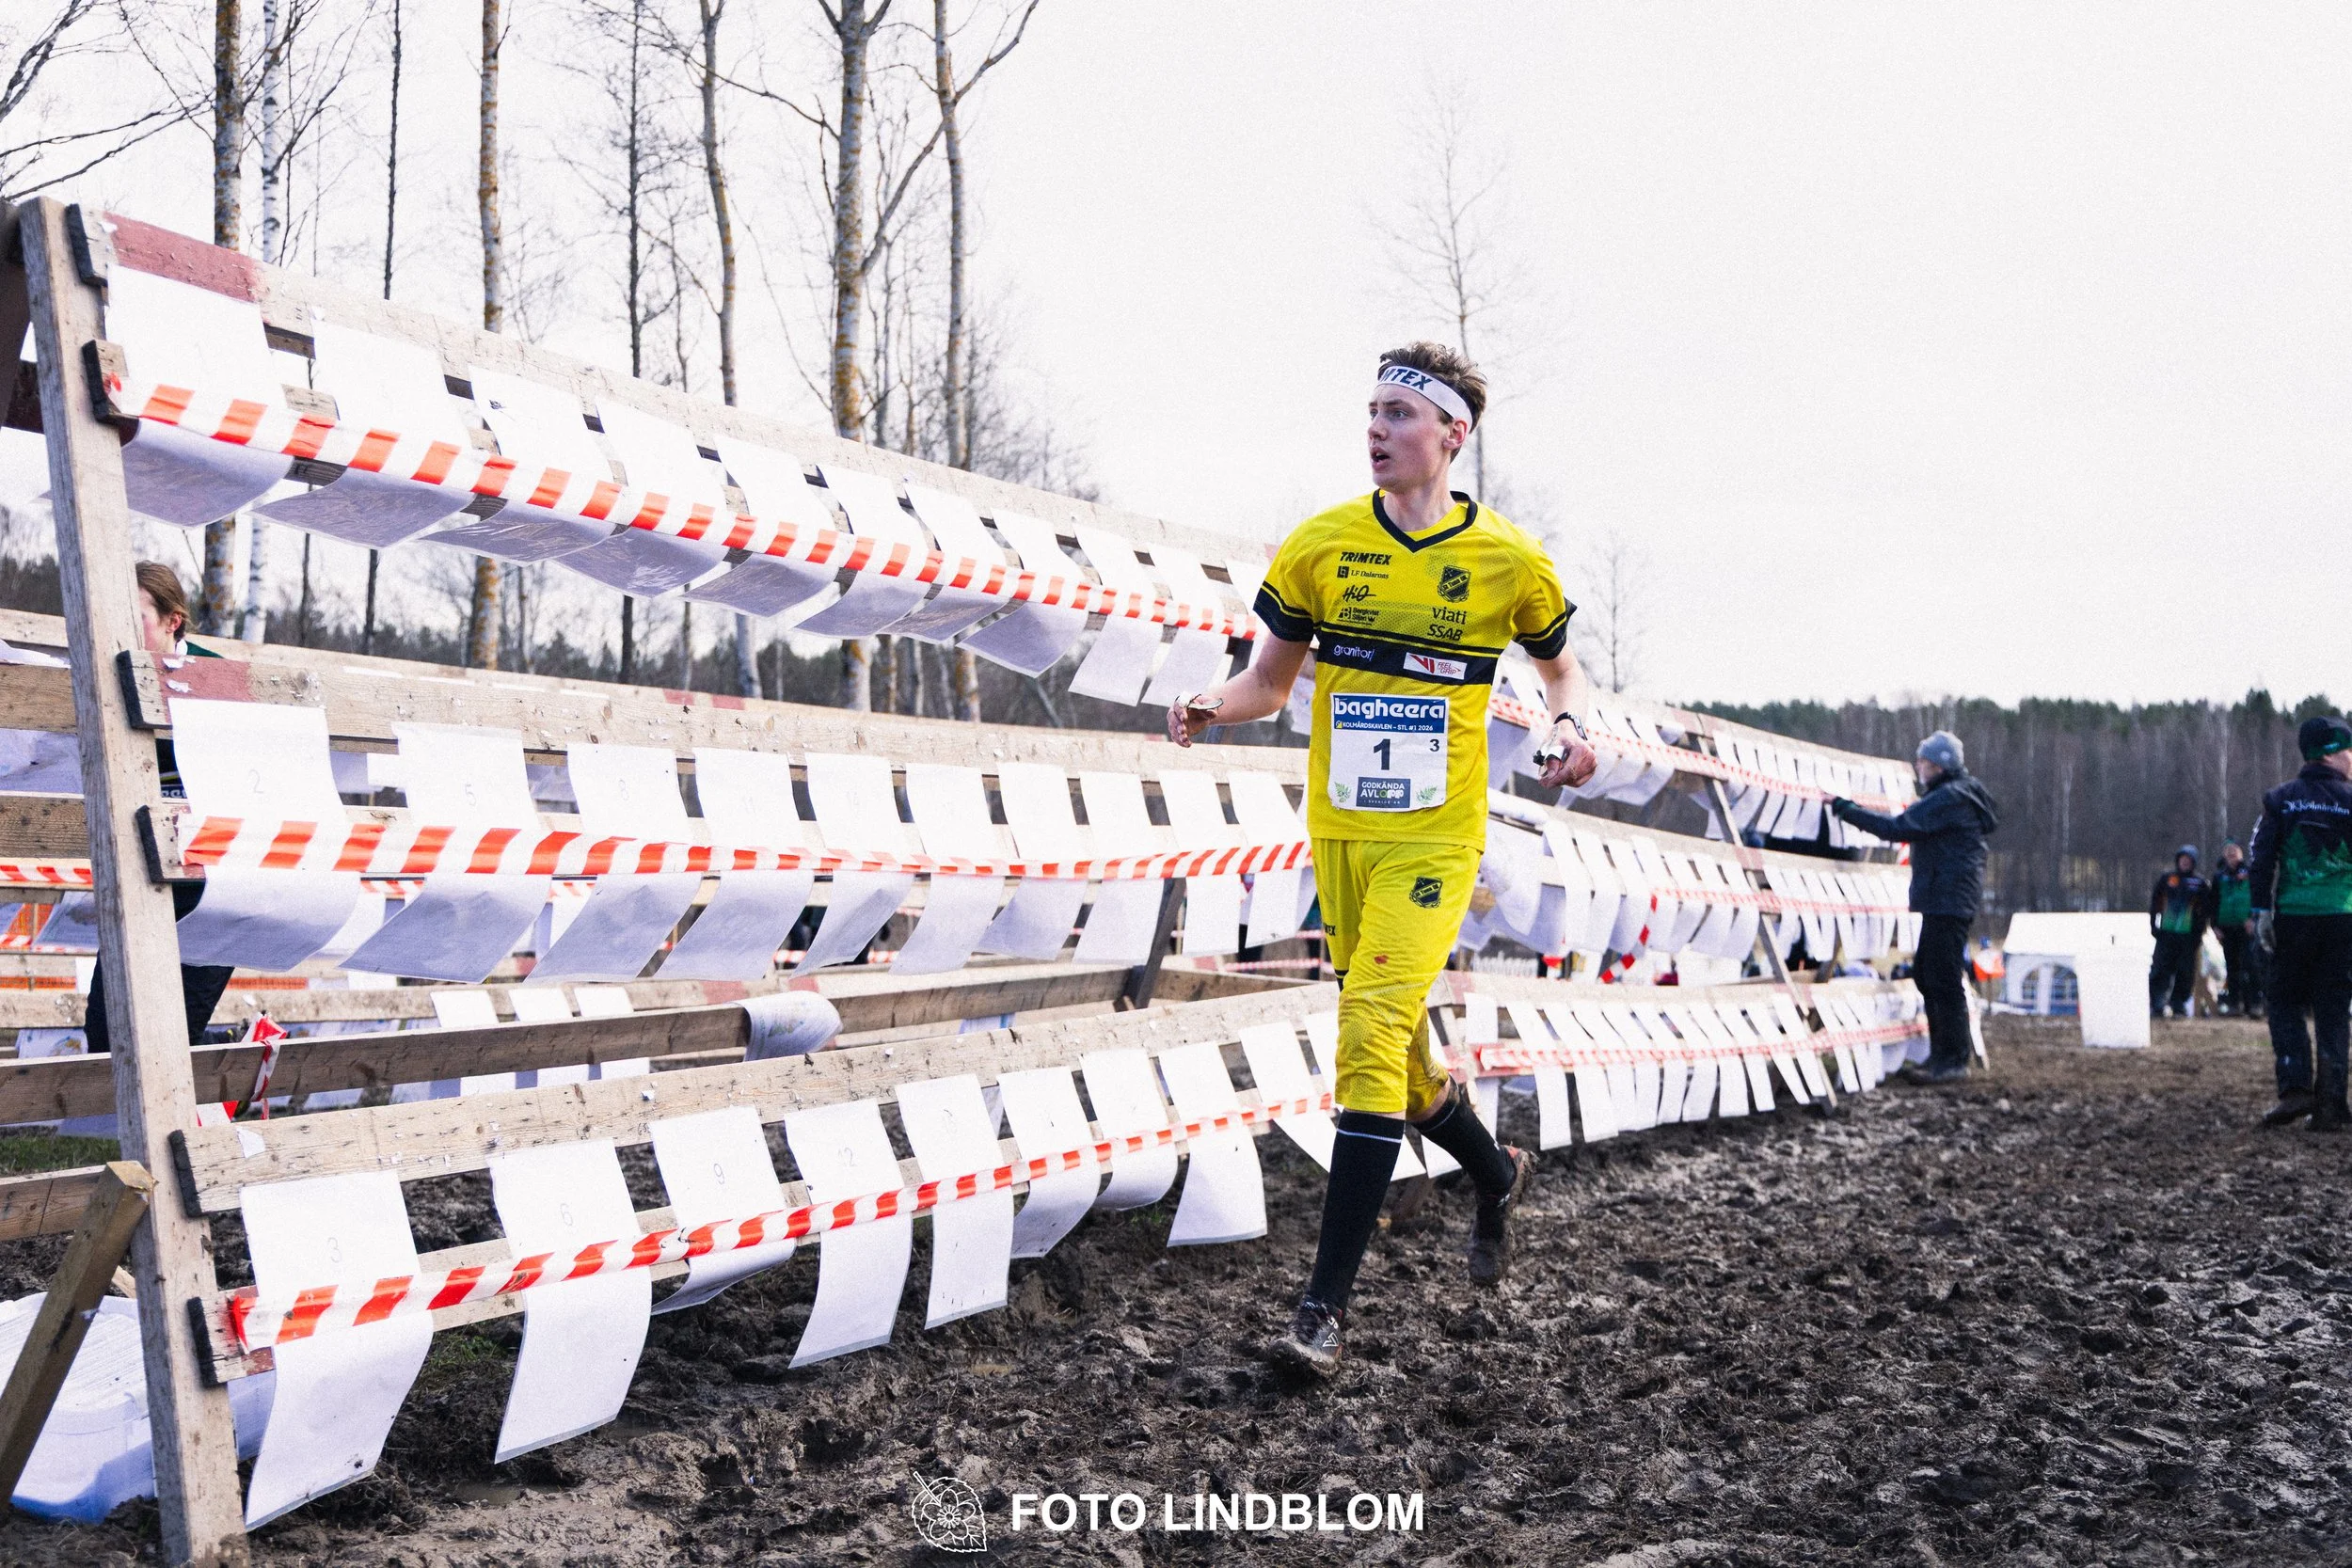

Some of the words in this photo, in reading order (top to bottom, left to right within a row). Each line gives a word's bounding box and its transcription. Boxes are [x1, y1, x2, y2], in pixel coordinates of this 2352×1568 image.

[1340, 551, 1392, 565] TRIMTEX
[1432, 606, 1467, 625] viati
[1427, 623, 1463, 641] SSAB
[1334, 697, 1445, 720] bagheera
[1343, 721, 1392, 731] KOLMÅRDSKAVLEN
[1374, 738, 1391, 770] 1
[1429, 738, 1440, 752] 3
[247, 768, 264, 794] 2
[1361, 781, 1405, 790] GODKÄNDA
[1360, 789, 1405, 799] AVLOPP
[712, 1162, 725, 1186] 9
[559, 1201, 574, 1227] 6
[326, 1236, 343, 1264] 3
